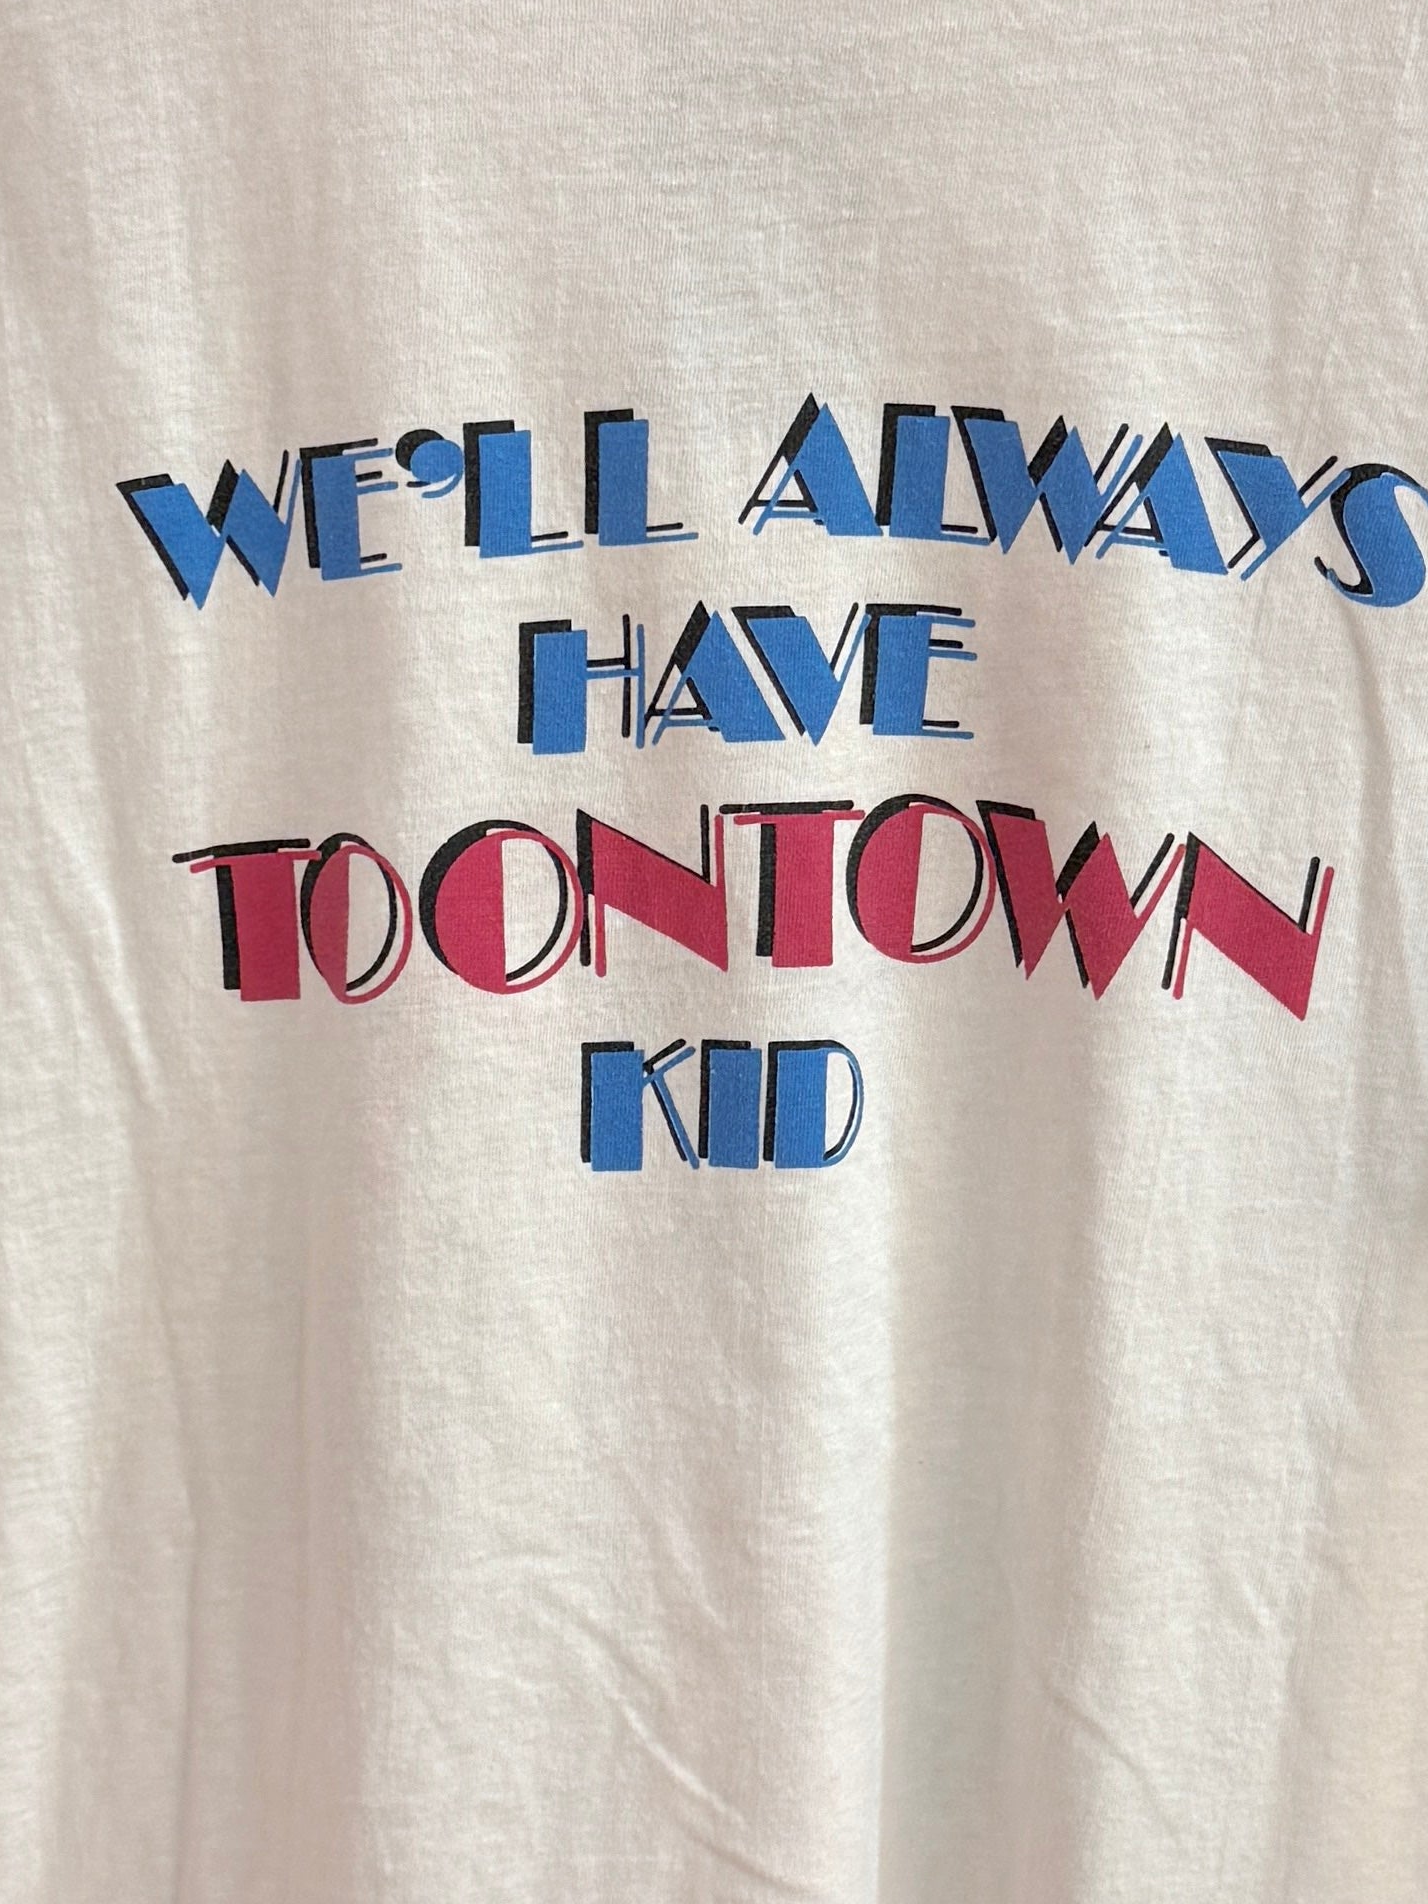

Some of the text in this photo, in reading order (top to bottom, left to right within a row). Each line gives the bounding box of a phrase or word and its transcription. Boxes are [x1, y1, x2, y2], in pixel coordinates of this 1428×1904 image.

[115, 408, 698, 611] WE'LL
[517, 599, 978, 756] HAVE
[172, 792, 1335, 1021] TOONTOWN
[580, 1038, 864, 1172] KID
